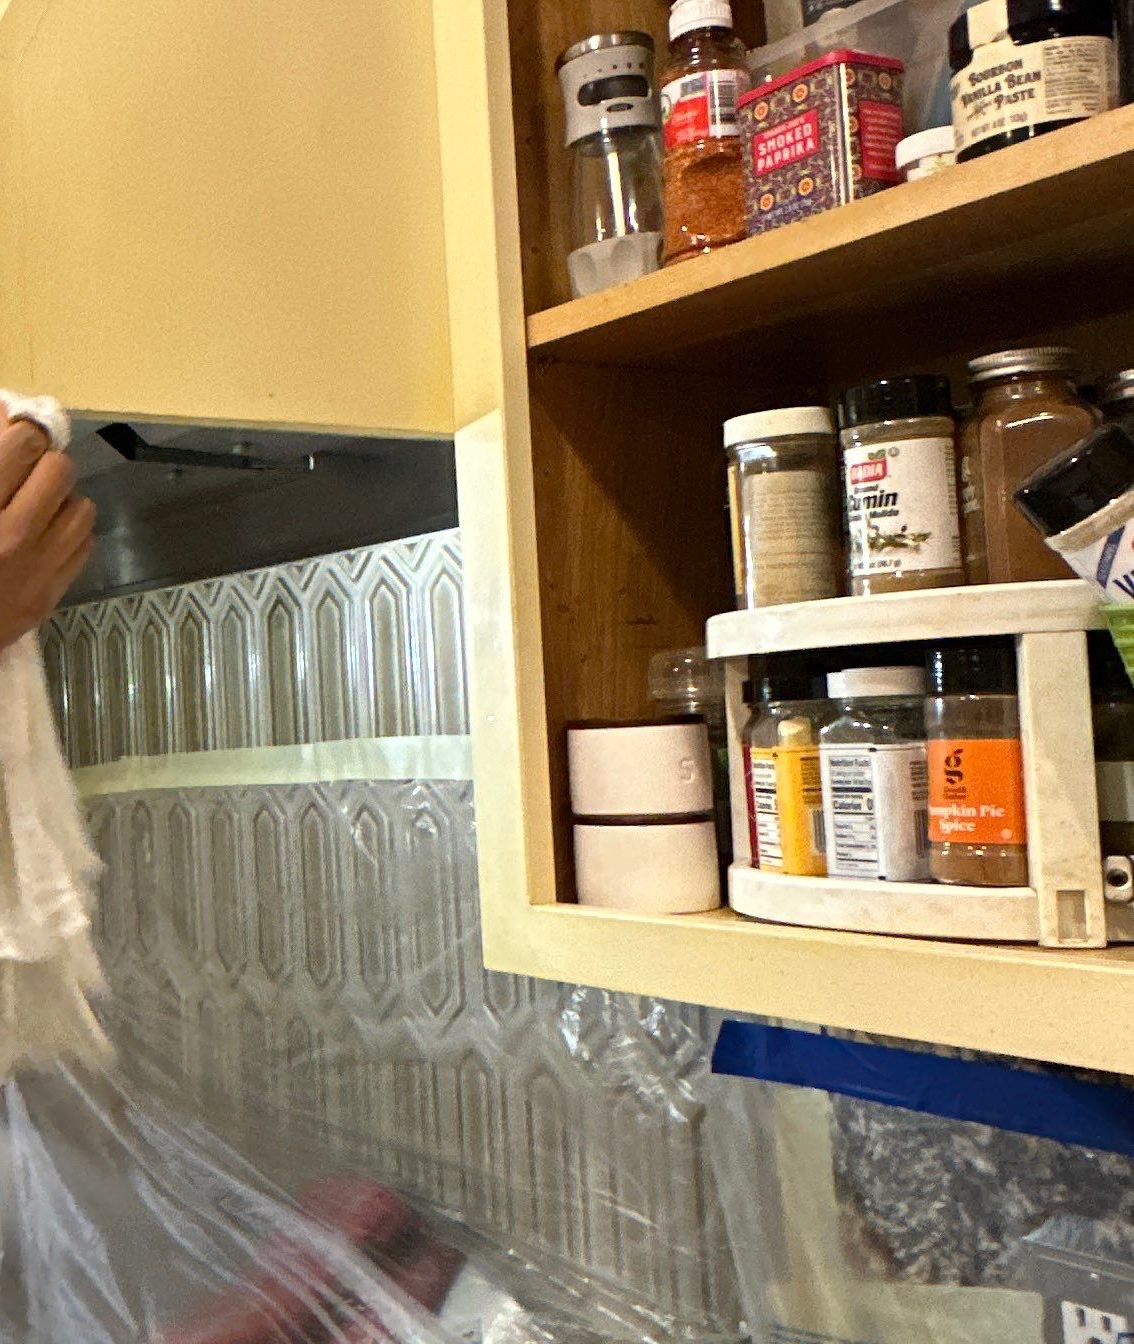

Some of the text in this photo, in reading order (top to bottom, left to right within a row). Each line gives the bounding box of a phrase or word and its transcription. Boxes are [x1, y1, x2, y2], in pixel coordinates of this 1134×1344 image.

[968, 59, 1023, 86] BOURBON
[961, 69, 1042, 108] VANILLA BEAN
[993, 88, 1035, 108] PASTE
[757, 122, 813, 156] SMOKED
[756, 137, 815, 173] PAPRIKA
[979, 803, 1006, 818] Pie
